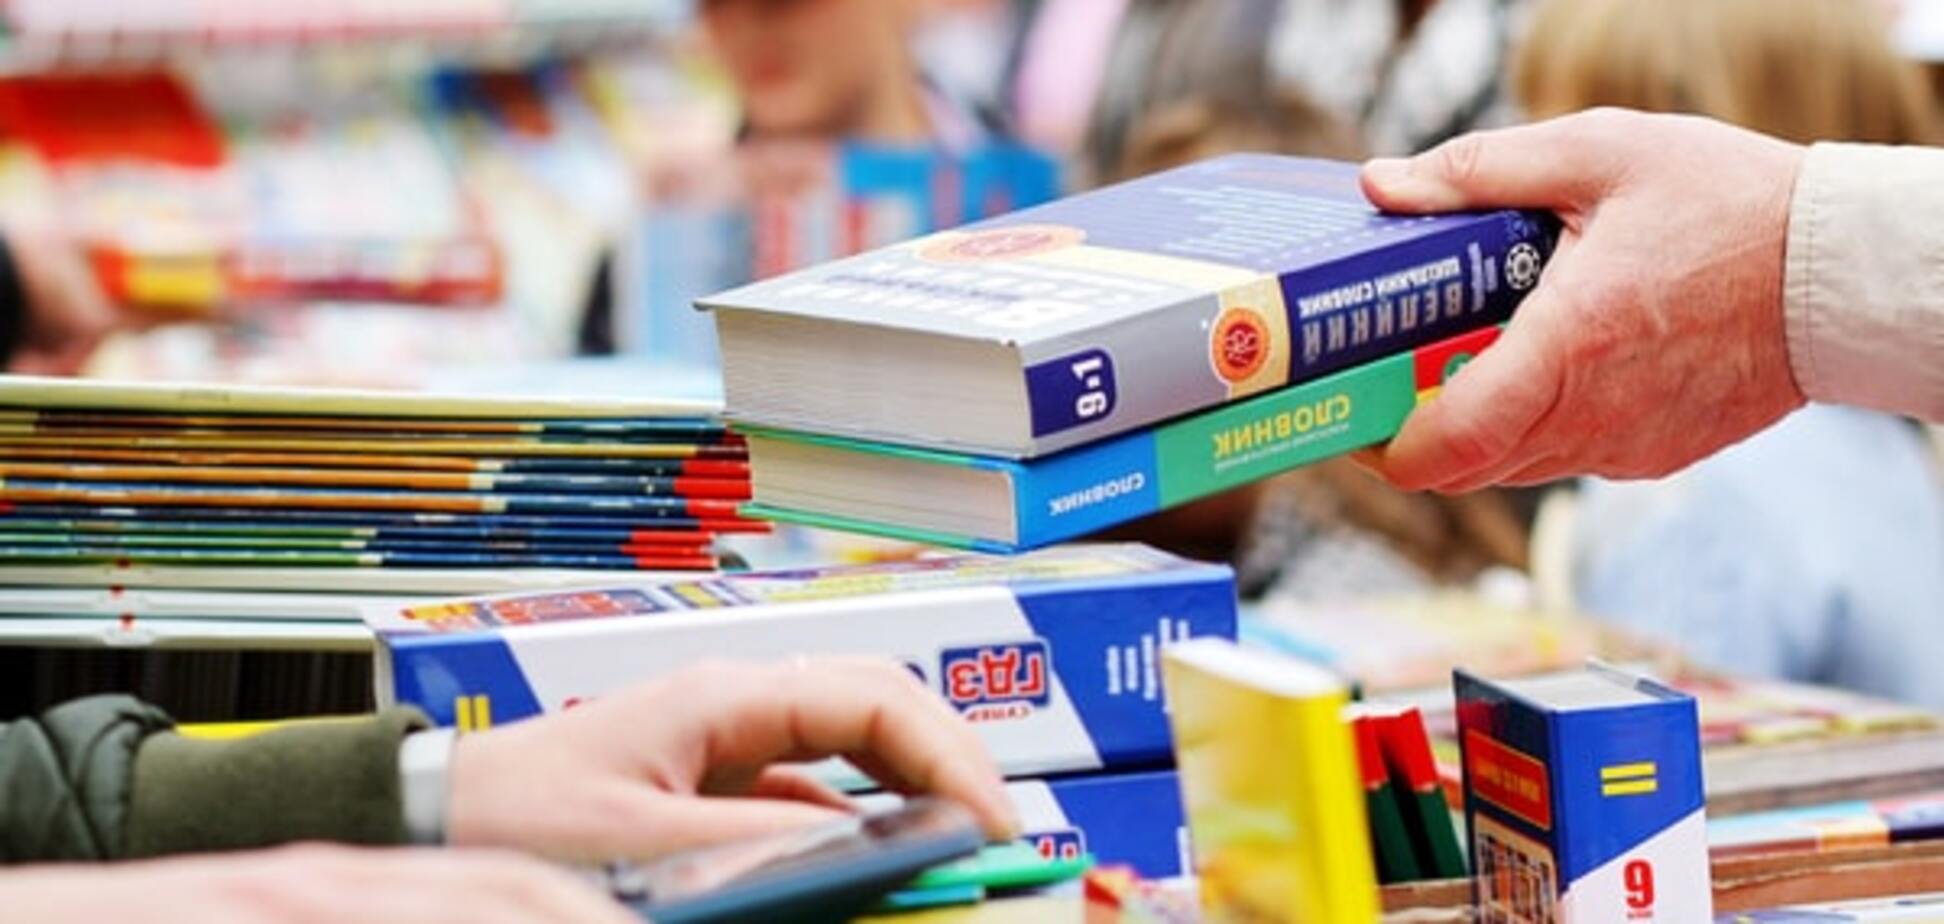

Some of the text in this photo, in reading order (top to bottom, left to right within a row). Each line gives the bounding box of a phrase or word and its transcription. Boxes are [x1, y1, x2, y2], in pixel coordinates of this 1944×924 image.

[1302, 281, 1463, 365] ВЕЛИКИЙ
[1212, 394, 1351, 460] СЛОВНИК
[1049, 472, 1145, 516] СЛОВНИК
[949, 650, 1045, 700] ГДЗ
[1623, 858, 1655, 909] 9
